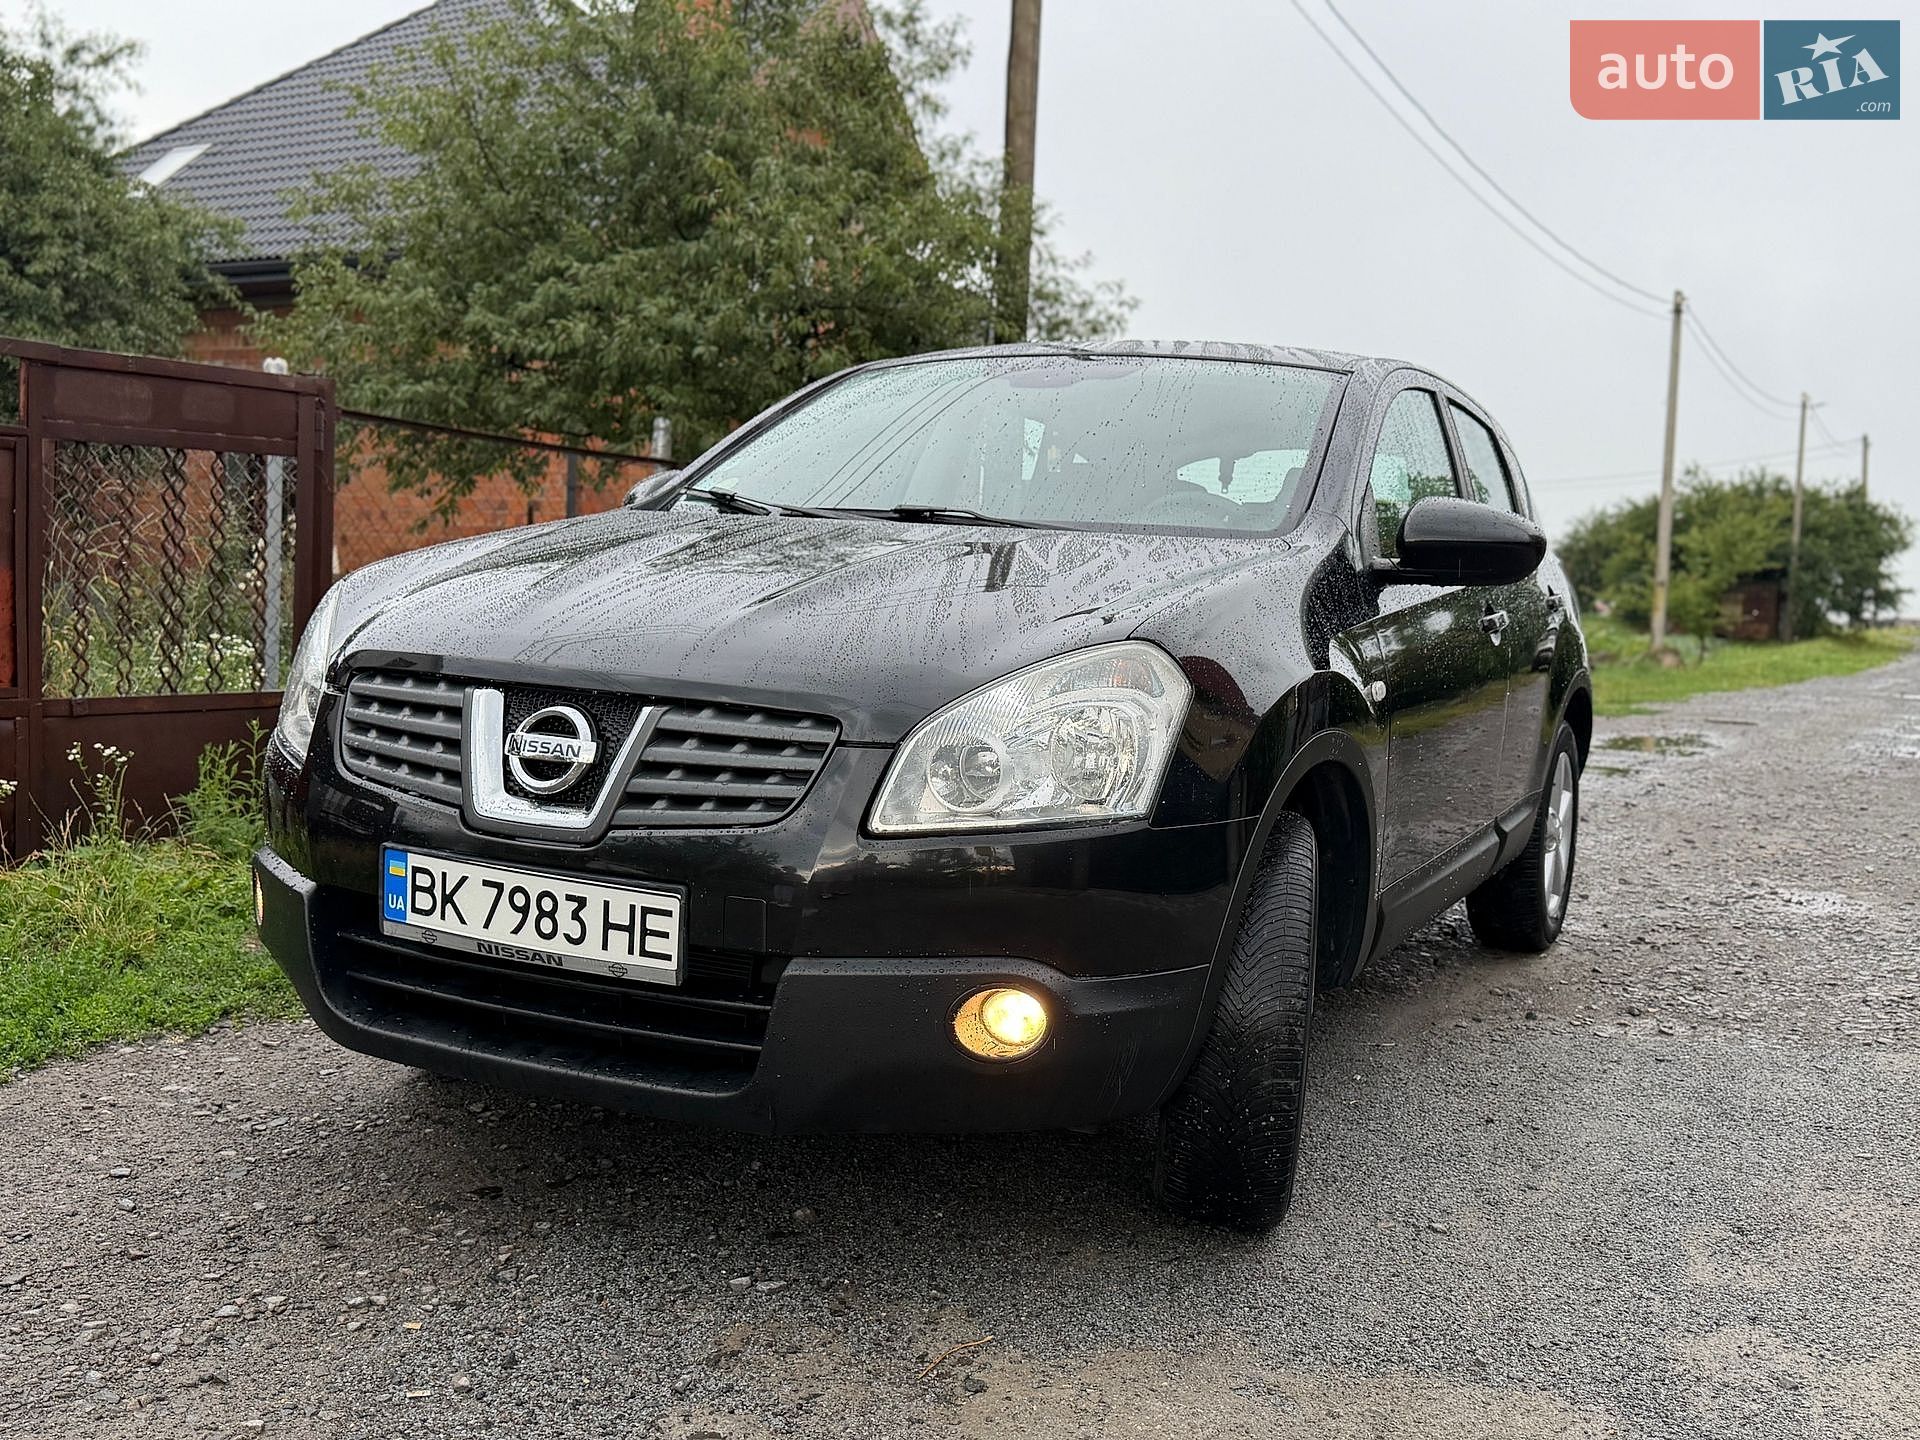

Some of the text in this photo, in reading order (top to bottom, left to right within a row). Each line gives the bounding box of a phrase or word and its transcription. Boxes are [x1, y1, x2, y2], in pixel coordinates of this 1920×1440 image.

[508, 734, 581, 758] NISSAN
[388, 894, 405, 911] UA
[410, 865, 673, 962] BK 7983 HE
[476, 942, 563, 967] NISSAN
